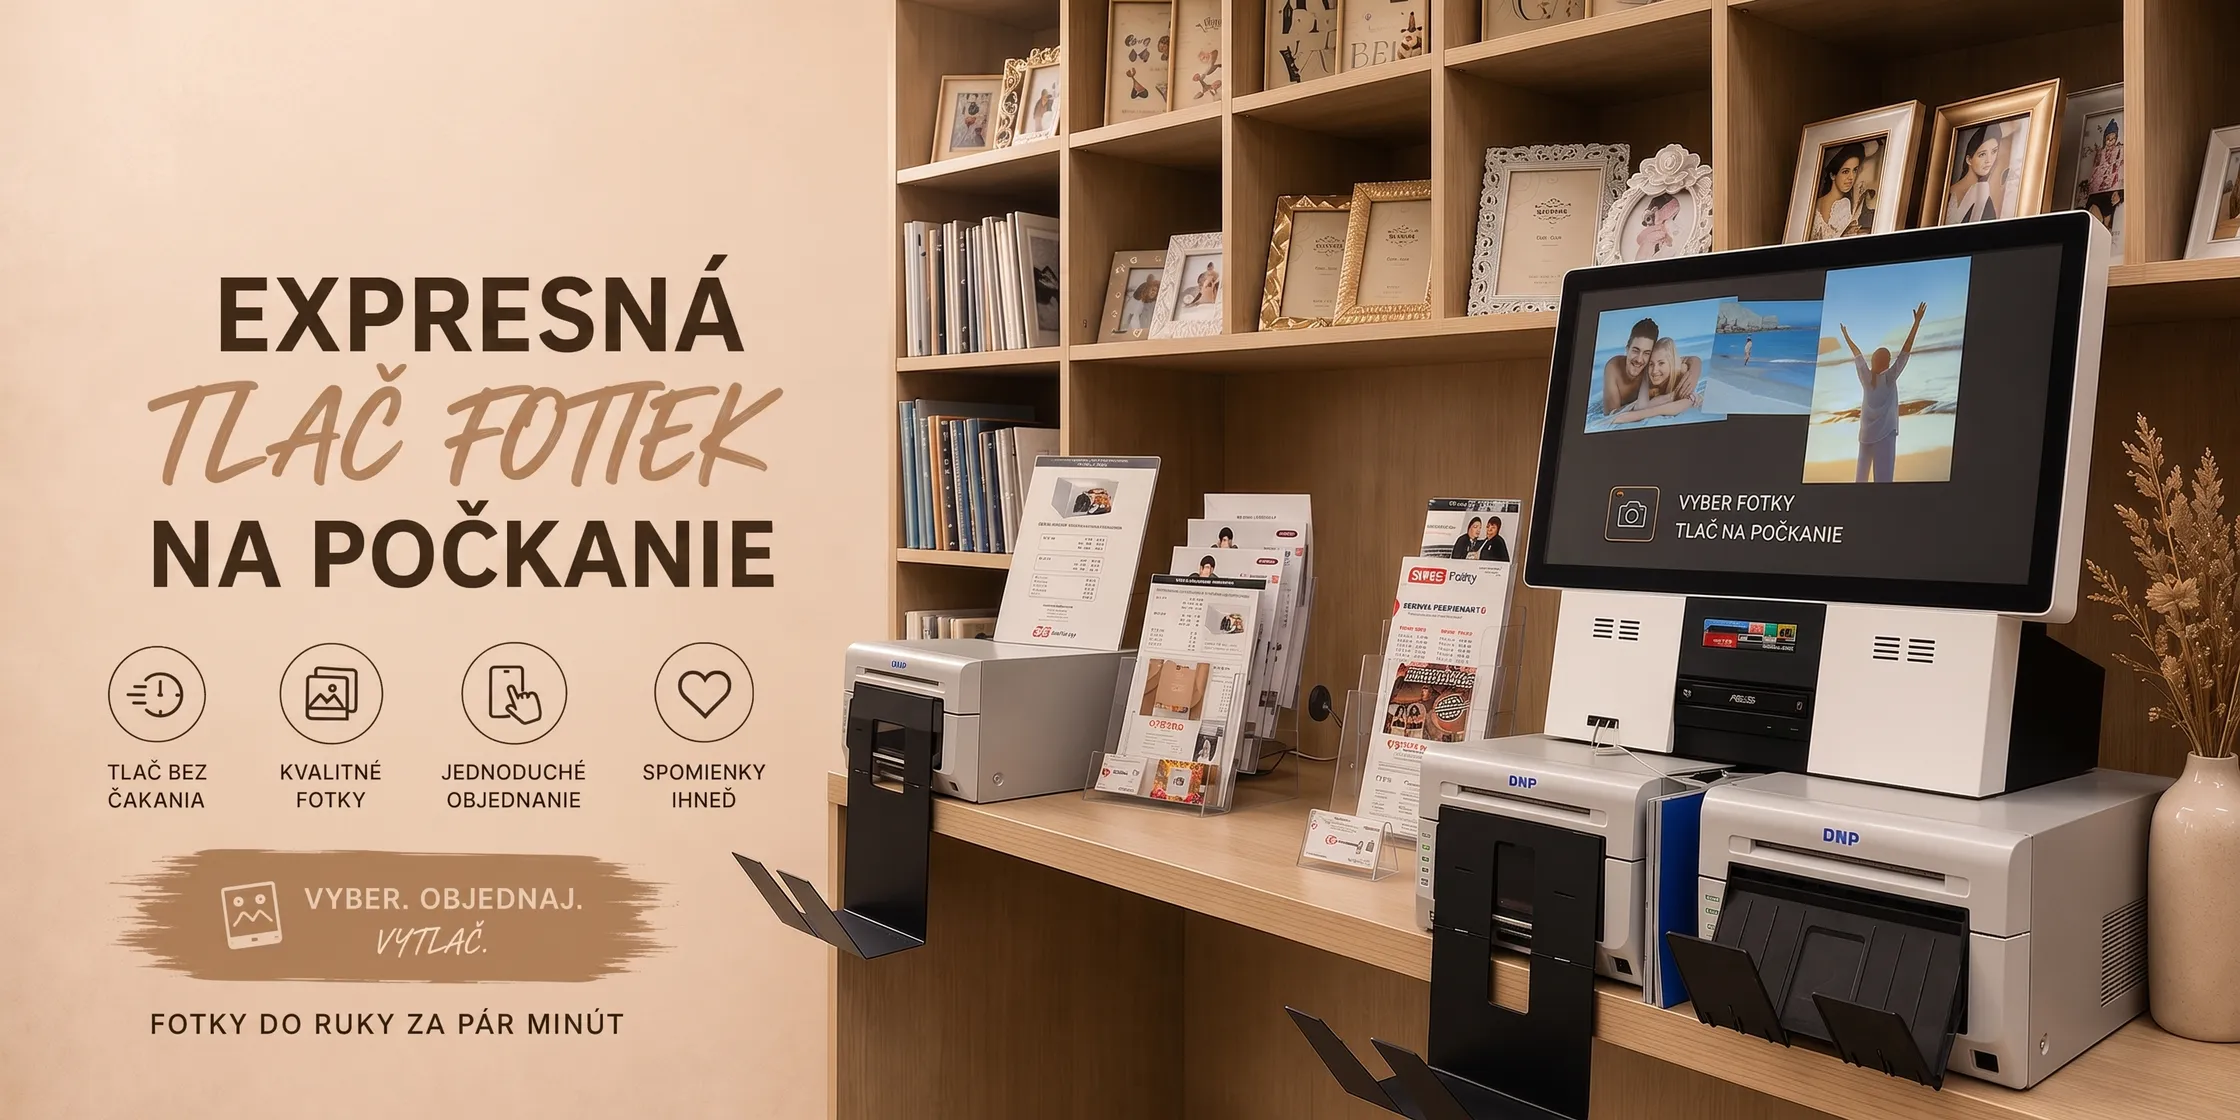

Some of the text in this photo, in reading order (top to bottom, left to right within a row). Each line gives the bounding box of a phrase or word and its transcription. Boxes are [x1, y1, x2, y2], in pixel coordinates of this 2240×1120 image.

[1680, 495, 1794, 511] VYBER FOTKY
[1676, 519, 1843, 542] TLAČ NA POČKANIE
[1509, 776, 1536, 788] DNP
[1824, 828, 1859, 845] DNP
